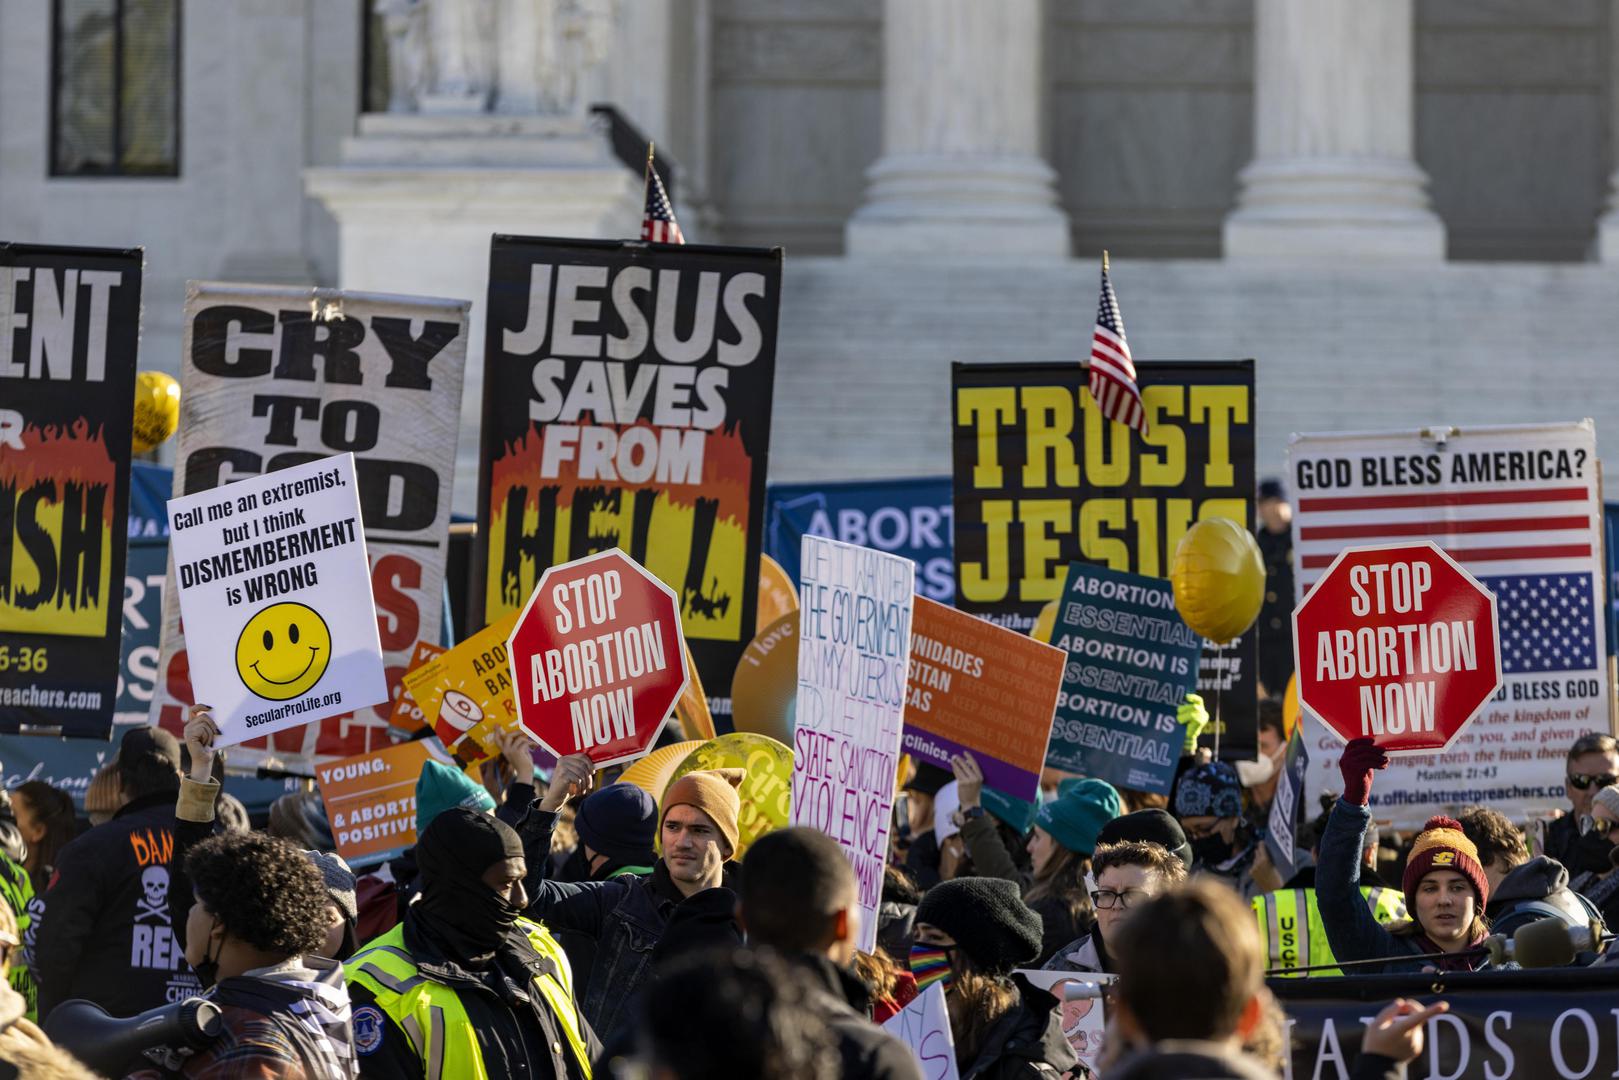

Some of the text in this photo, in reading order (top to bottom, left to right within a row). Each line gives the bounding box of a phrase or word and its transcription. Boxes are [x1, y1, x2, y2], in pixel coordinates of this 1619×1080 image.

[503, 263, 766, 367] JESUS
[191, 305, 460, 391] CRY
[529, 357, 729, 431] SAVES
[253, 394, 380, 452] TO
[957, 384, 1249, 488] TRUST
[540, 424, 706, 485] FROM
[1296, 448, 1587, 490] GOD BLESS AMERICA?
[173, 506, 204, 531] Call
[207, 500, 233, 522] me
[237, 493, 260, 513] an
[262, 468, 347, 506] extremist,
[184, 446, 440, 532] GD
[179, 518, 356, 589] DISMEMBERMENT
[222, 507, 306, 546] but I think
[226, 562, 318, 606] is WRONG
[552, 570, 622, 634] STOP
[800, 582, 828, 640] THE
[1072, 576, 1175, 610] ABORTION
[1349, 560, 1432, 617] STOP
[1063, 601, 1198, 649] ESSENTIAL
[1316, 620, 1478, 682] ABORTION
[530, 620, 667, 705] ABORTION
[822, 645, 846, 691] MY
[1057, 634, 1189, 676] ABORTION IS
[246, 691, 341, 728] SecularProLife.org
[569, 686, 636, 751] NOW
[1359, 681, 1436, 737] NOW
[1488, 709, 1509, 724] the
[1513, 707, 1571, 725] kingdom
[1575, 706, 1590, 720] of
[1512, 681, 1561, 701] BLESS
[1566, 679, 1599, 698] GOD
[1155, 713, 1177, 733] IS
[1511, 728, 1537, 742] and
[1540, 728, 1575, 743] given
[795, 728, 835, 779] STATE
[1389, 754, 1437, 768] ringing
[1474, 750, 1495, 762] the
[334, 814, 345, 828] &
[791, 771, 890, 859] VIOLENCE
[1283, 1008, 1619, 1080] ADS O
